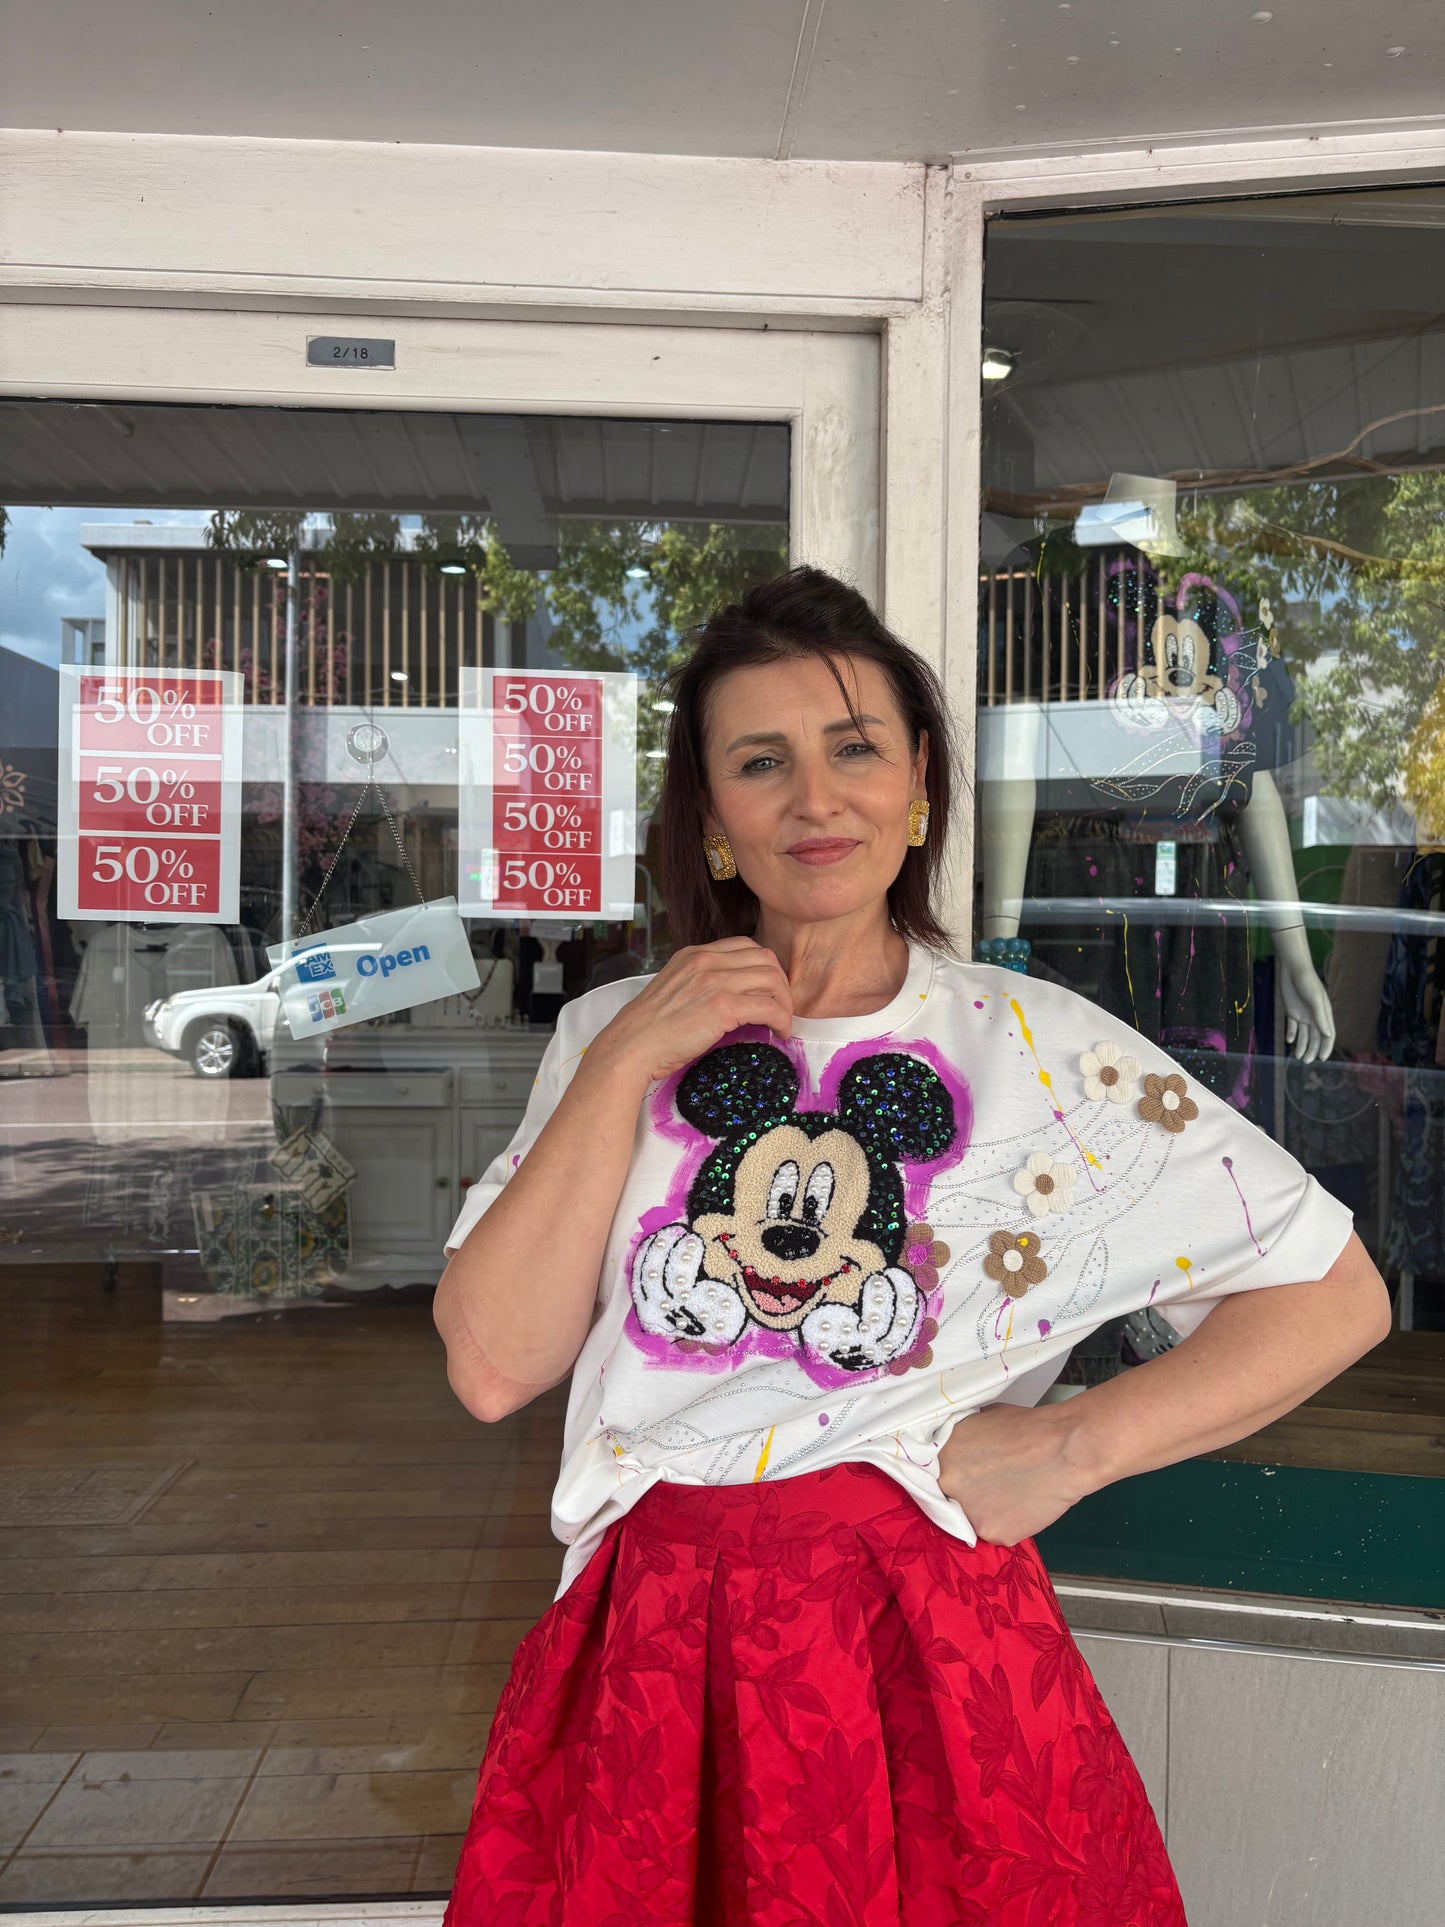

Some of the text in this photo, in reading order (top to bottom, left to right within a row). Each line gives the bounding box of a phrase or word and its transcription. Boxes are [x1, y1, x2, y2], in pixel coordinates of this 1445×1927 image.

[333, 346, 369, 359] 2/18
[94, 686, 196, 725] 50%
[503, 683, 583, 714] 50%
[544, 712, 593, 732] OFF
[147, 723, 209, 747] OFF
[503, 743, 582, 773] 50%
[93, 766, 195, 804] 50%
[544, 772, 593, 791] OFF
[146, 803, 208, 826] OFF
[503, 802, 582, 831] 50%
[543, 830, 592, 849] OFF
[92, 845, 194, 883] 50%
[503, 860, 581, 890] 50%
[144, 882, 207, 905] OFF
[543, 888, 592, 907] OFF
[309, 960, 335, 977] EX
[357, 944, 431, 977] Open
